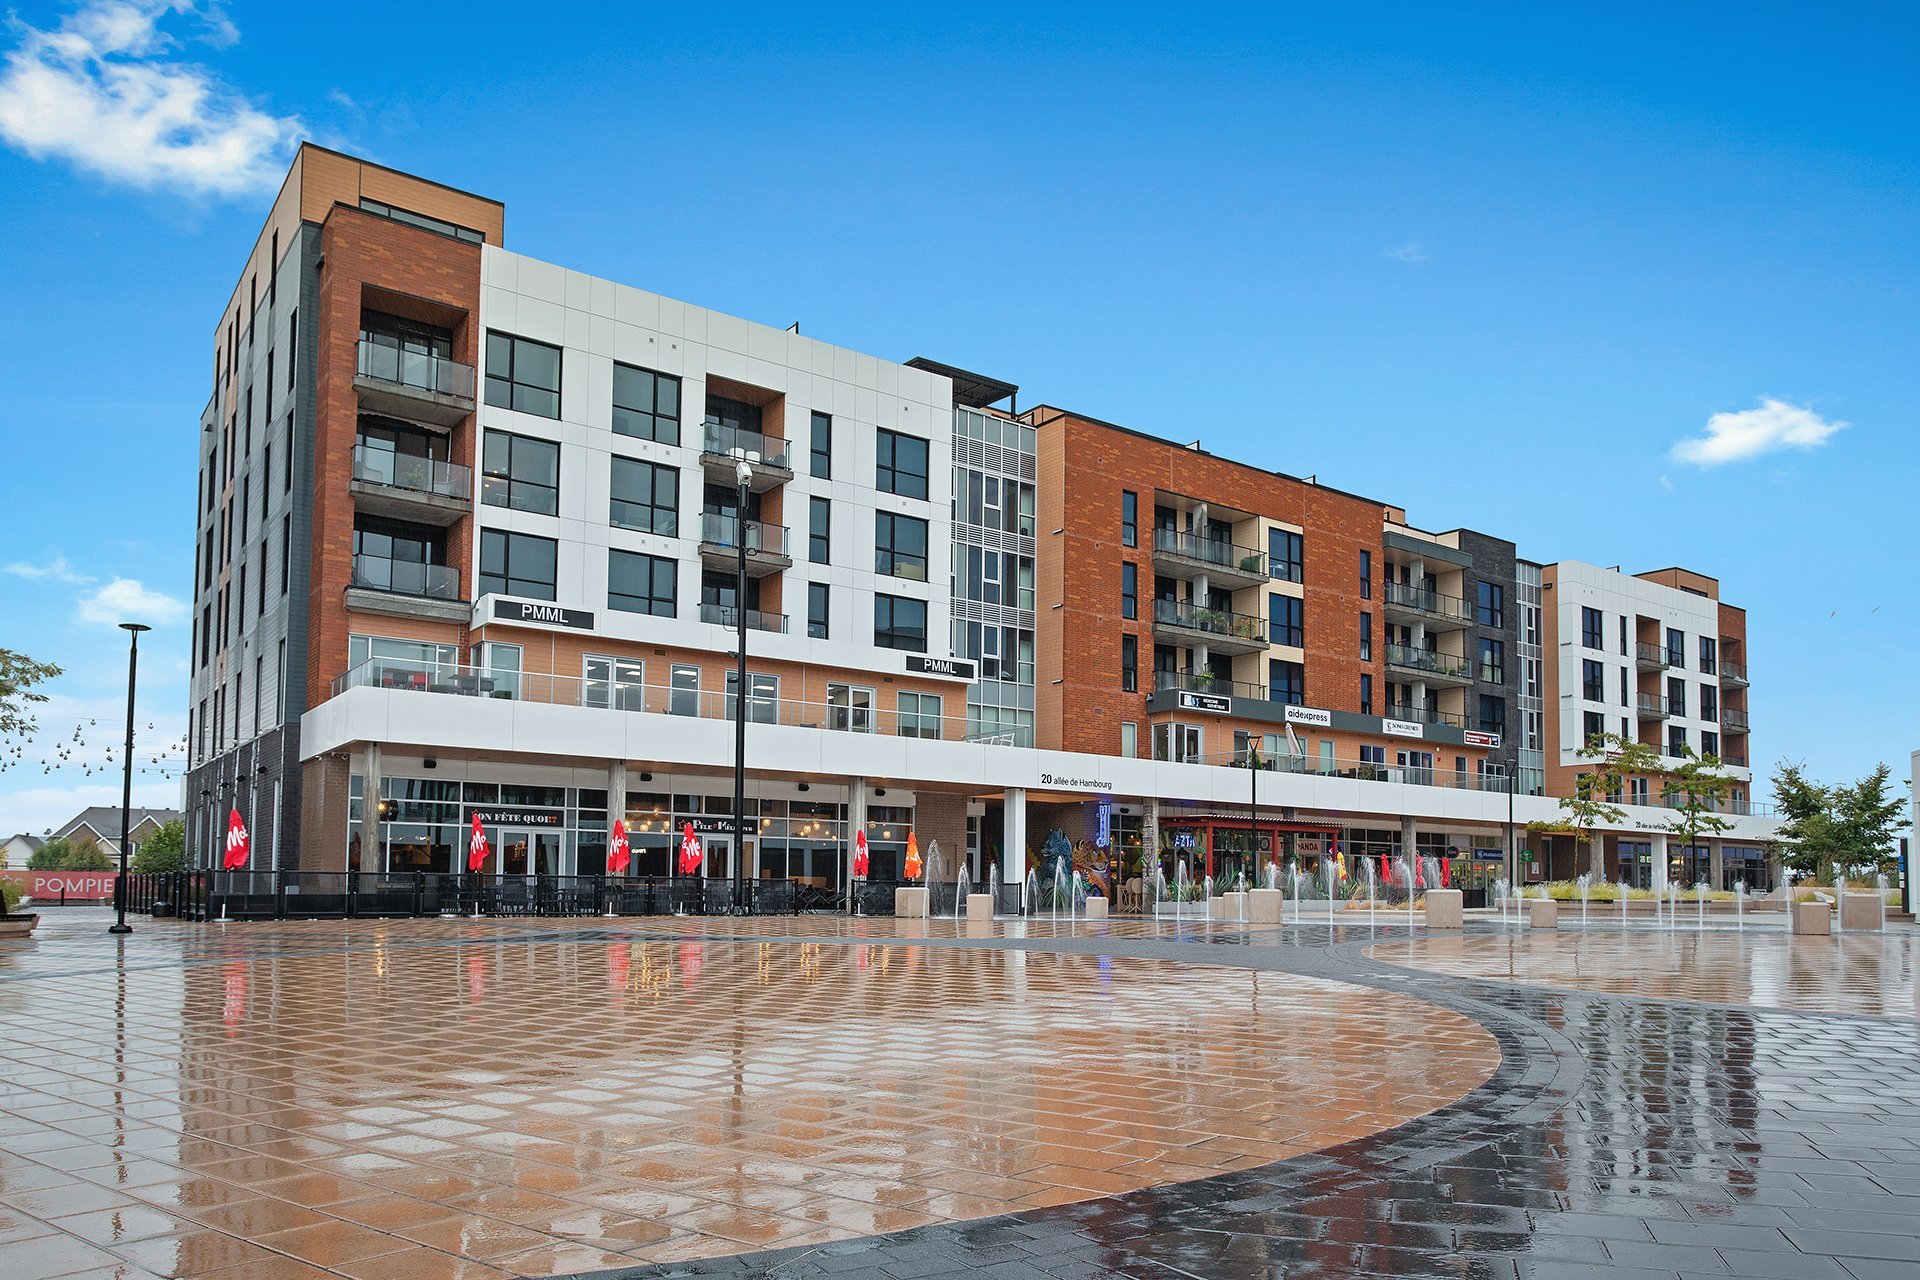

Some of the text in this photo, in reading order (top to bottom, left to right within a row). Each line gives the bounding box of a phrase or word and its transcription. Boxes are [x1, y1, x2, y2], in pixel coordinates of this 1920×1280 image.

[521, 604, 569, 623] PMML
[924, 658, 957, 674] PMML
[1288, 709, 1328, 722] aidexpress
[1041, 773, 1113, 791] 20 allée de Hambourg
[494, 811, 521, 822] FÊTE
[35, 877, 114, 893] POMPIE
